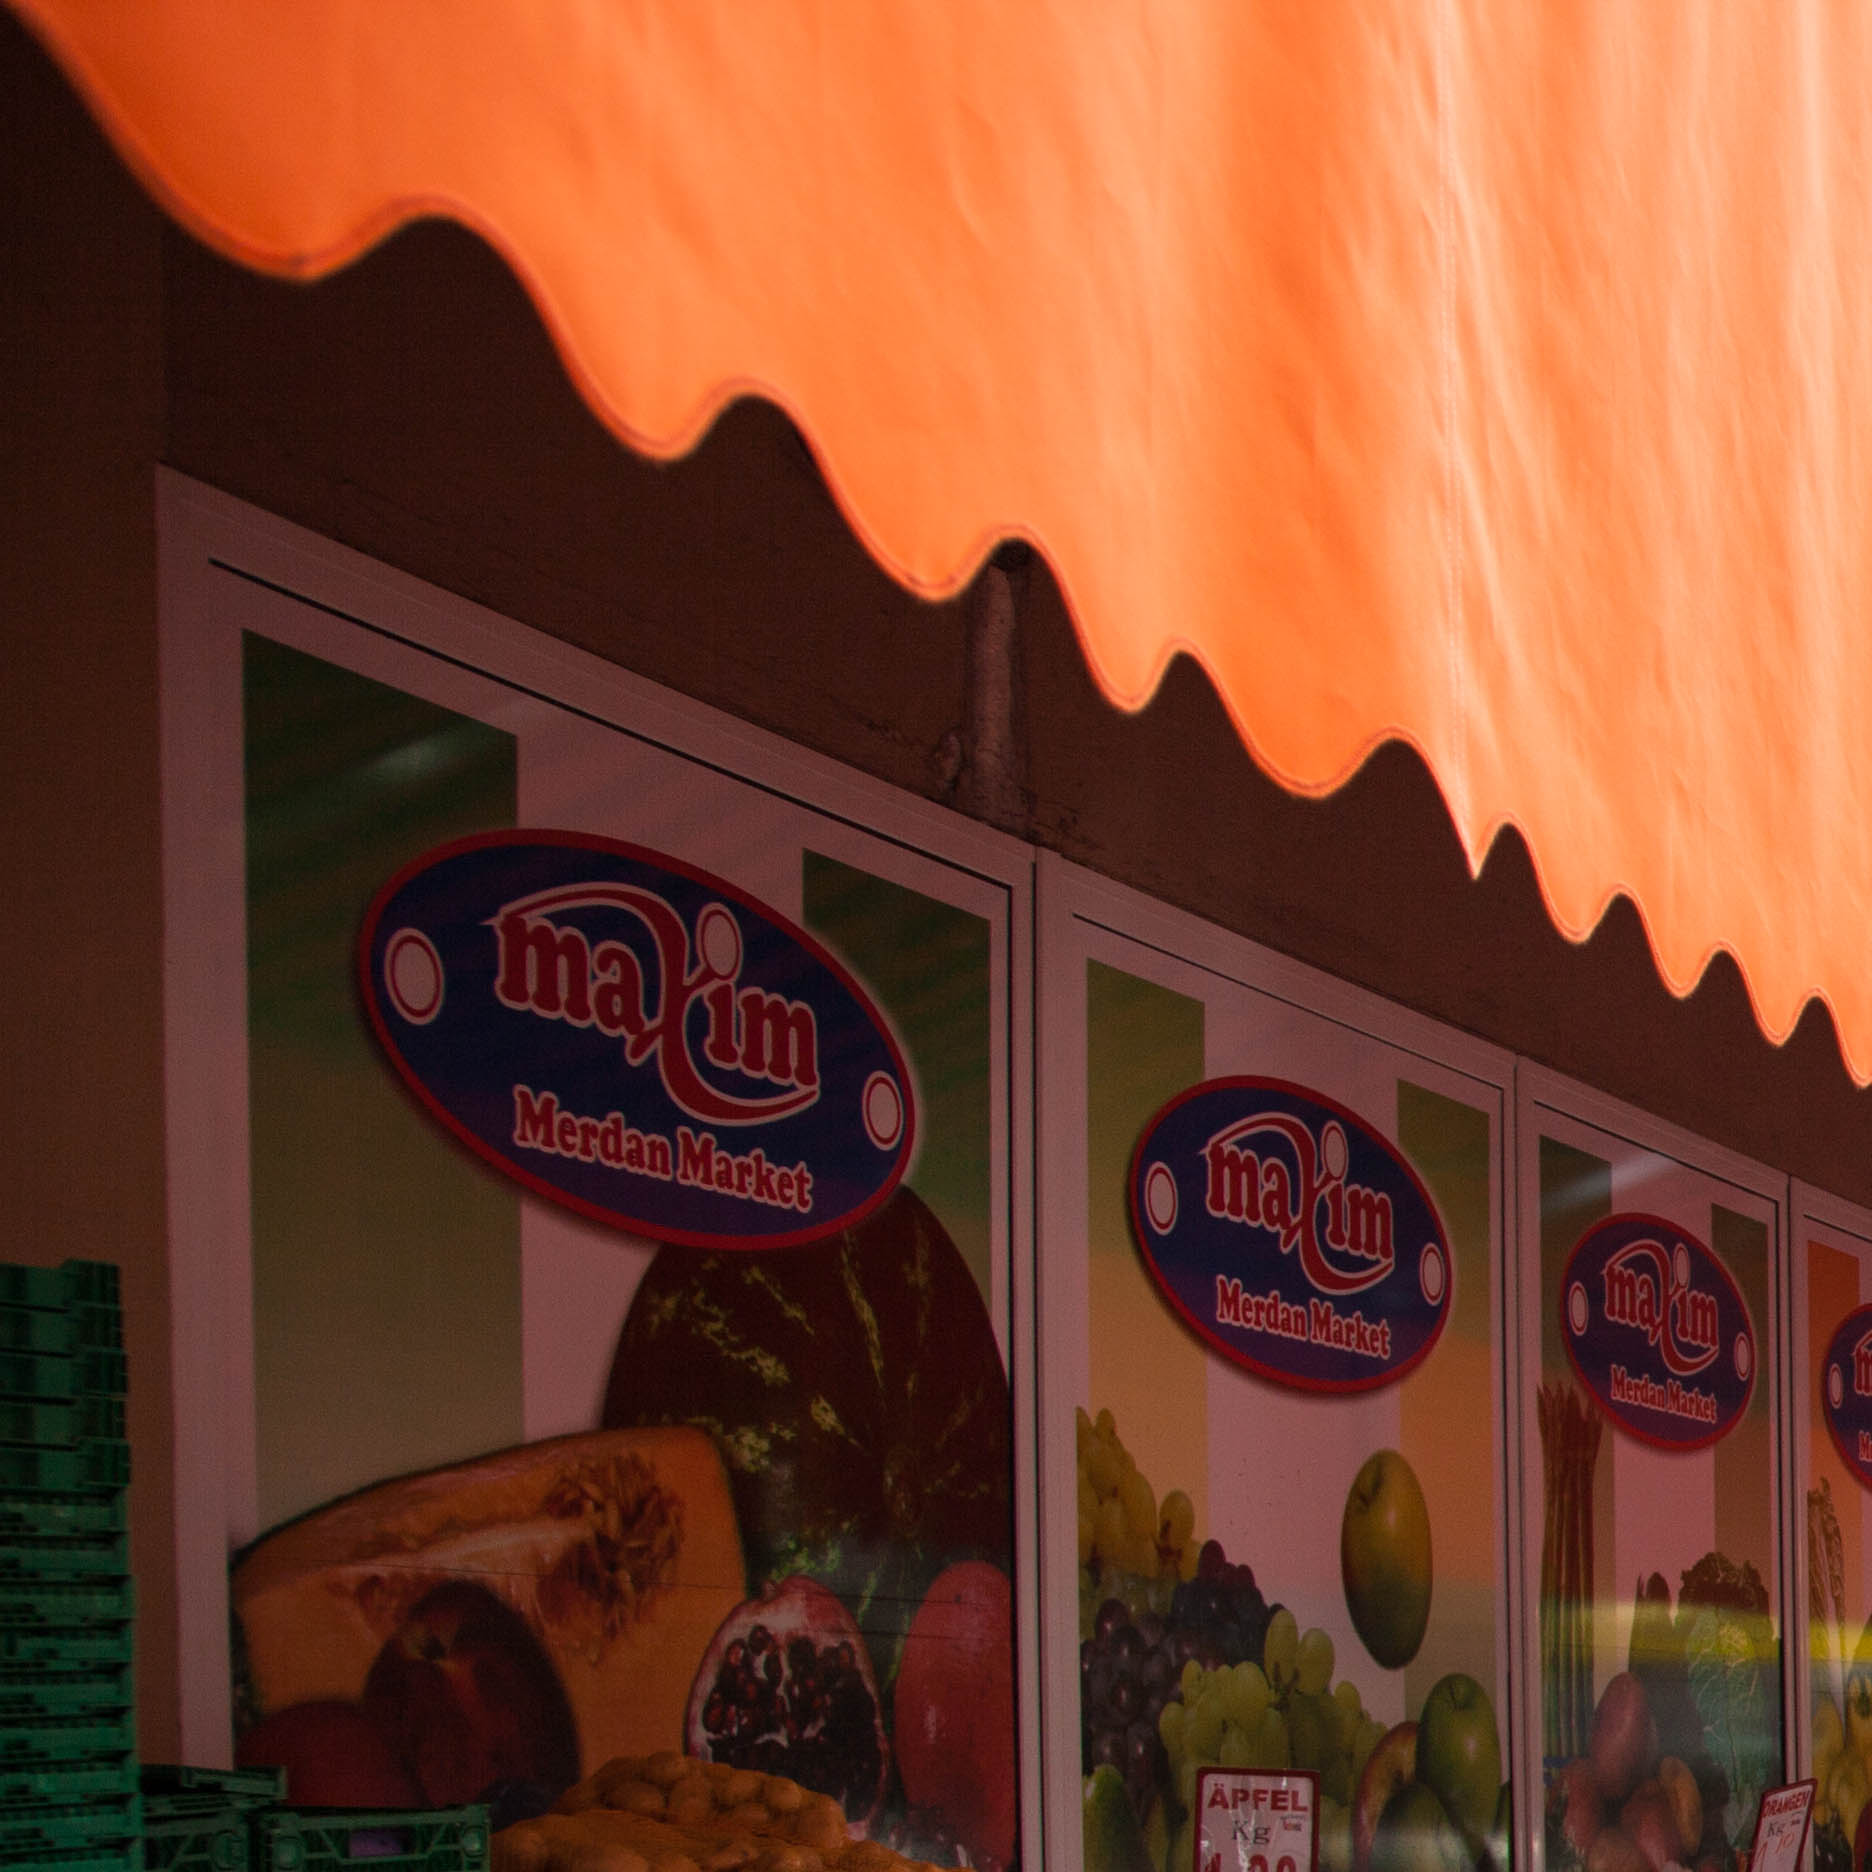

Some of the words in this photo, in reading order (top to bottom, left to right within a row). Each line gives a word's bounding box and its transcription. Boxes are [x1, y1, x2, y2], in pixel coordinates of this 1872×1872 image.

[486, 881, 820, 1127] maxim
[512, 1083, 672, 1182] Merdan
[676, 1125, 814, 1213] Market
[1198, 1112, 1395, 1295] maxim
[1215, 1274, 1306, 1341] Merdan
[1310, 1297, 1390, 1359] Market
[1602, 1238, 1719, 1376] maxim
[1610, 1364, 1665, 1412] Merdan
[1666, 1379, 1717, 1424] Market
[1208, 1783, 1308, 1812] ÄPFEL
[1232, 1820, 1271, 1845] Kg
